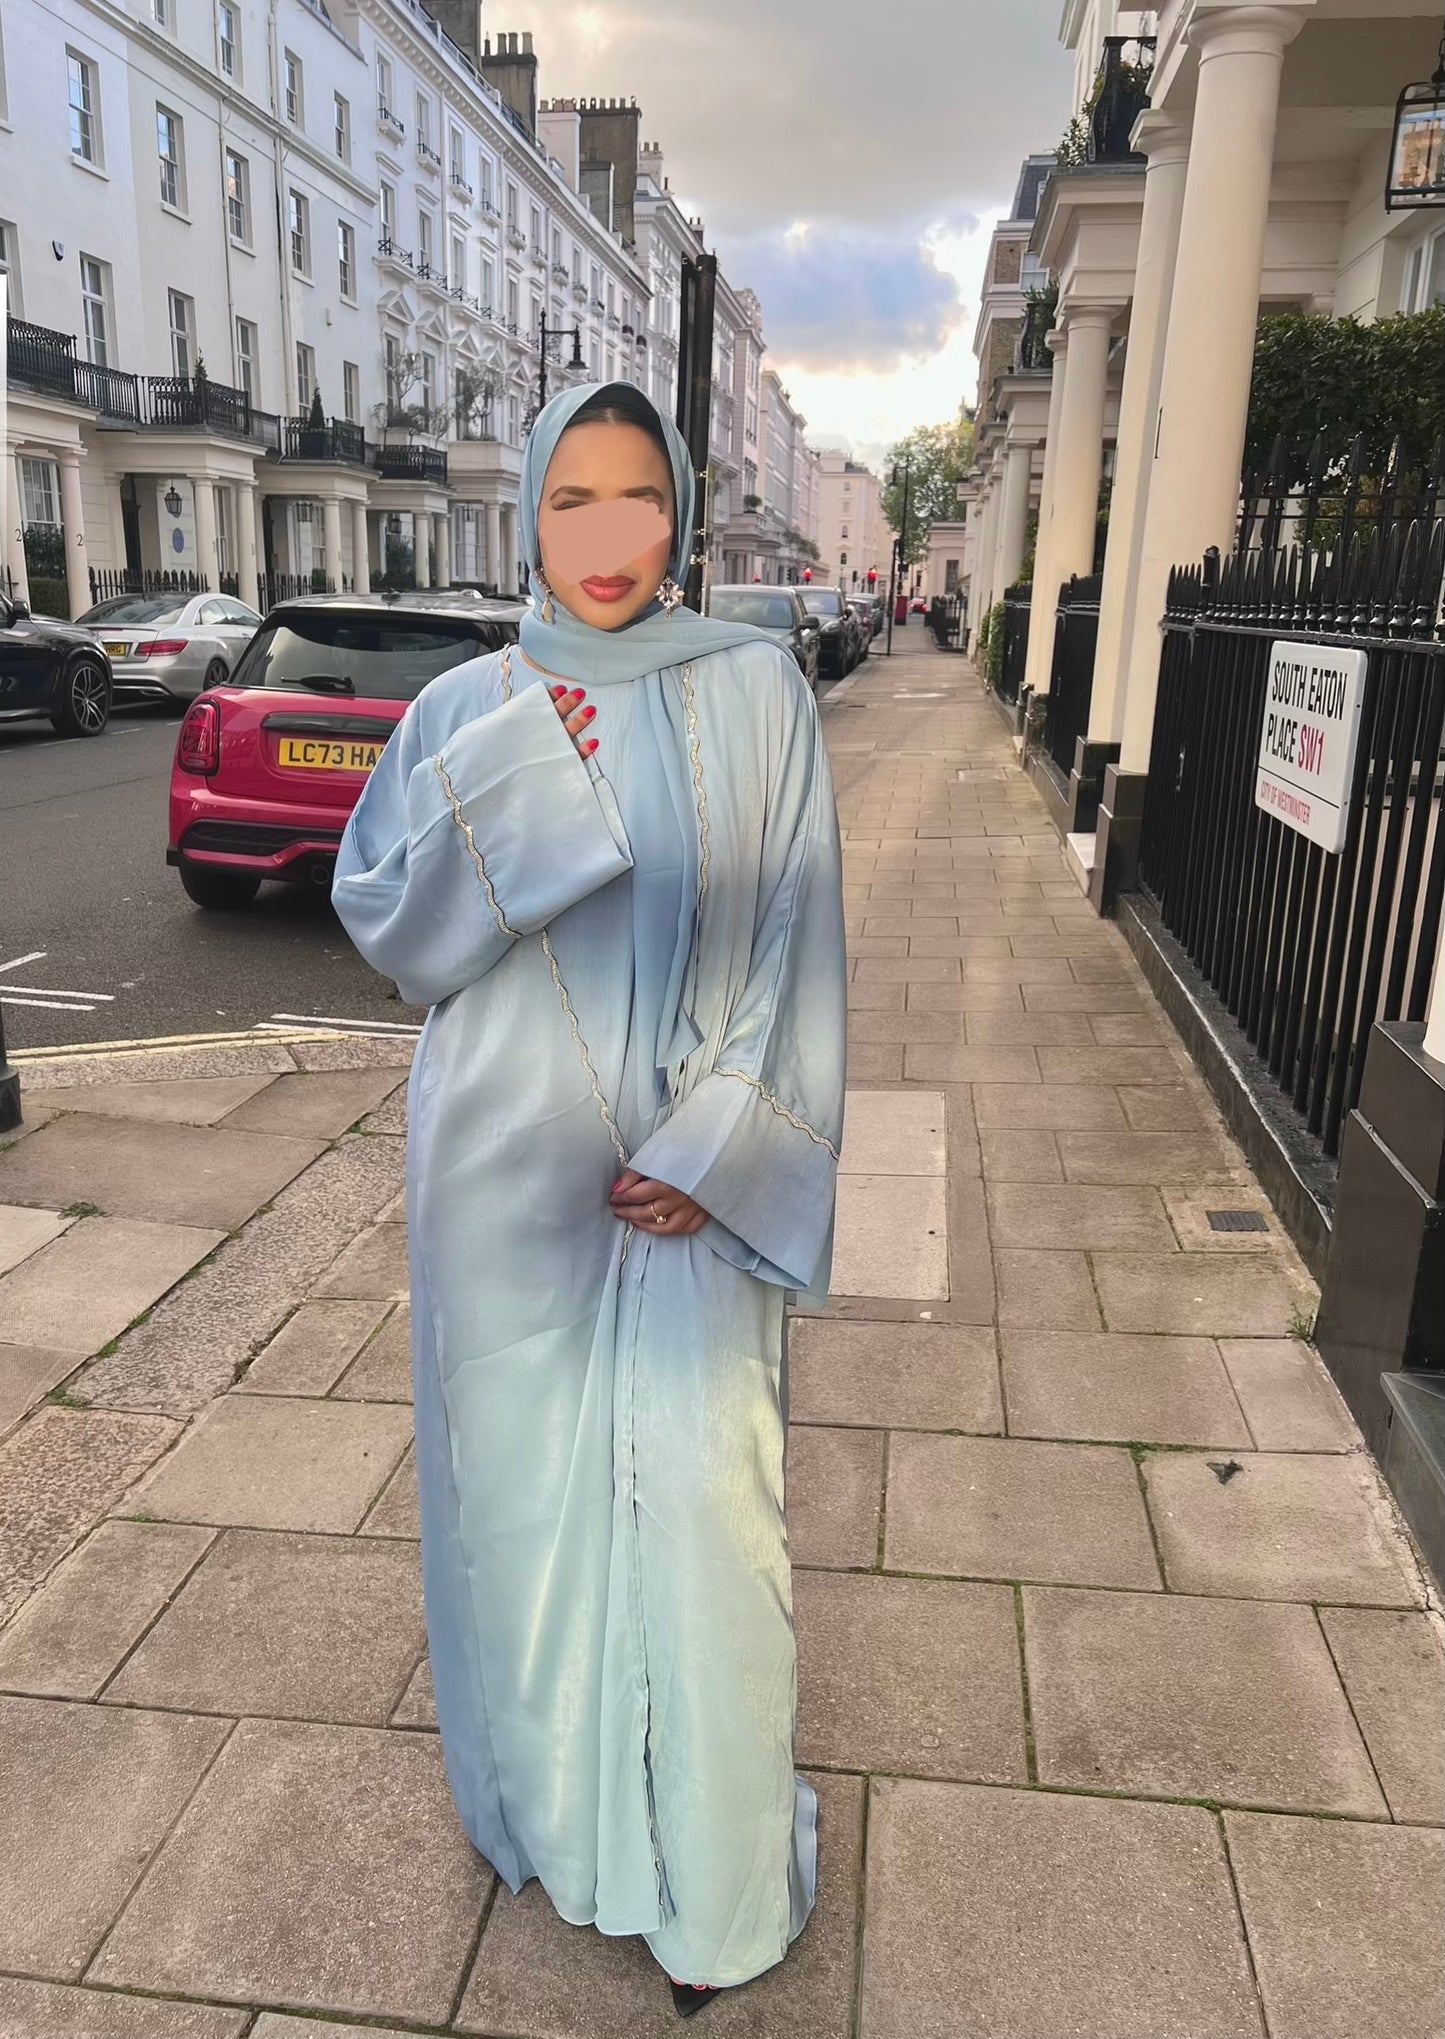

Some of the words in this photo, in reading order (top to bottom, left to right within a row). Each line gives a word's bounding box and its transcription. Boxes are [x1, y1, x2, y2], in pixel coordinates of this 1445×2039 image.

[14, 528, 22, 543] 2
[76, 533, 84, 547] 2
[1272, 661, 1307, 708] SOUTH
[1308, 667, 1347, 720] EATON
[288, 741, 345, 765] LC73
[350, 746, 384, 767] HA
[1266, 714, 1298, 763] PLACE
[1298, 723, 1325, 776] SW1
[1261, 780, 1271, 802] CITY
[1270, 785, 1278, 805] OF
[1277, 789, 1310, 825] WESTMINSTER
